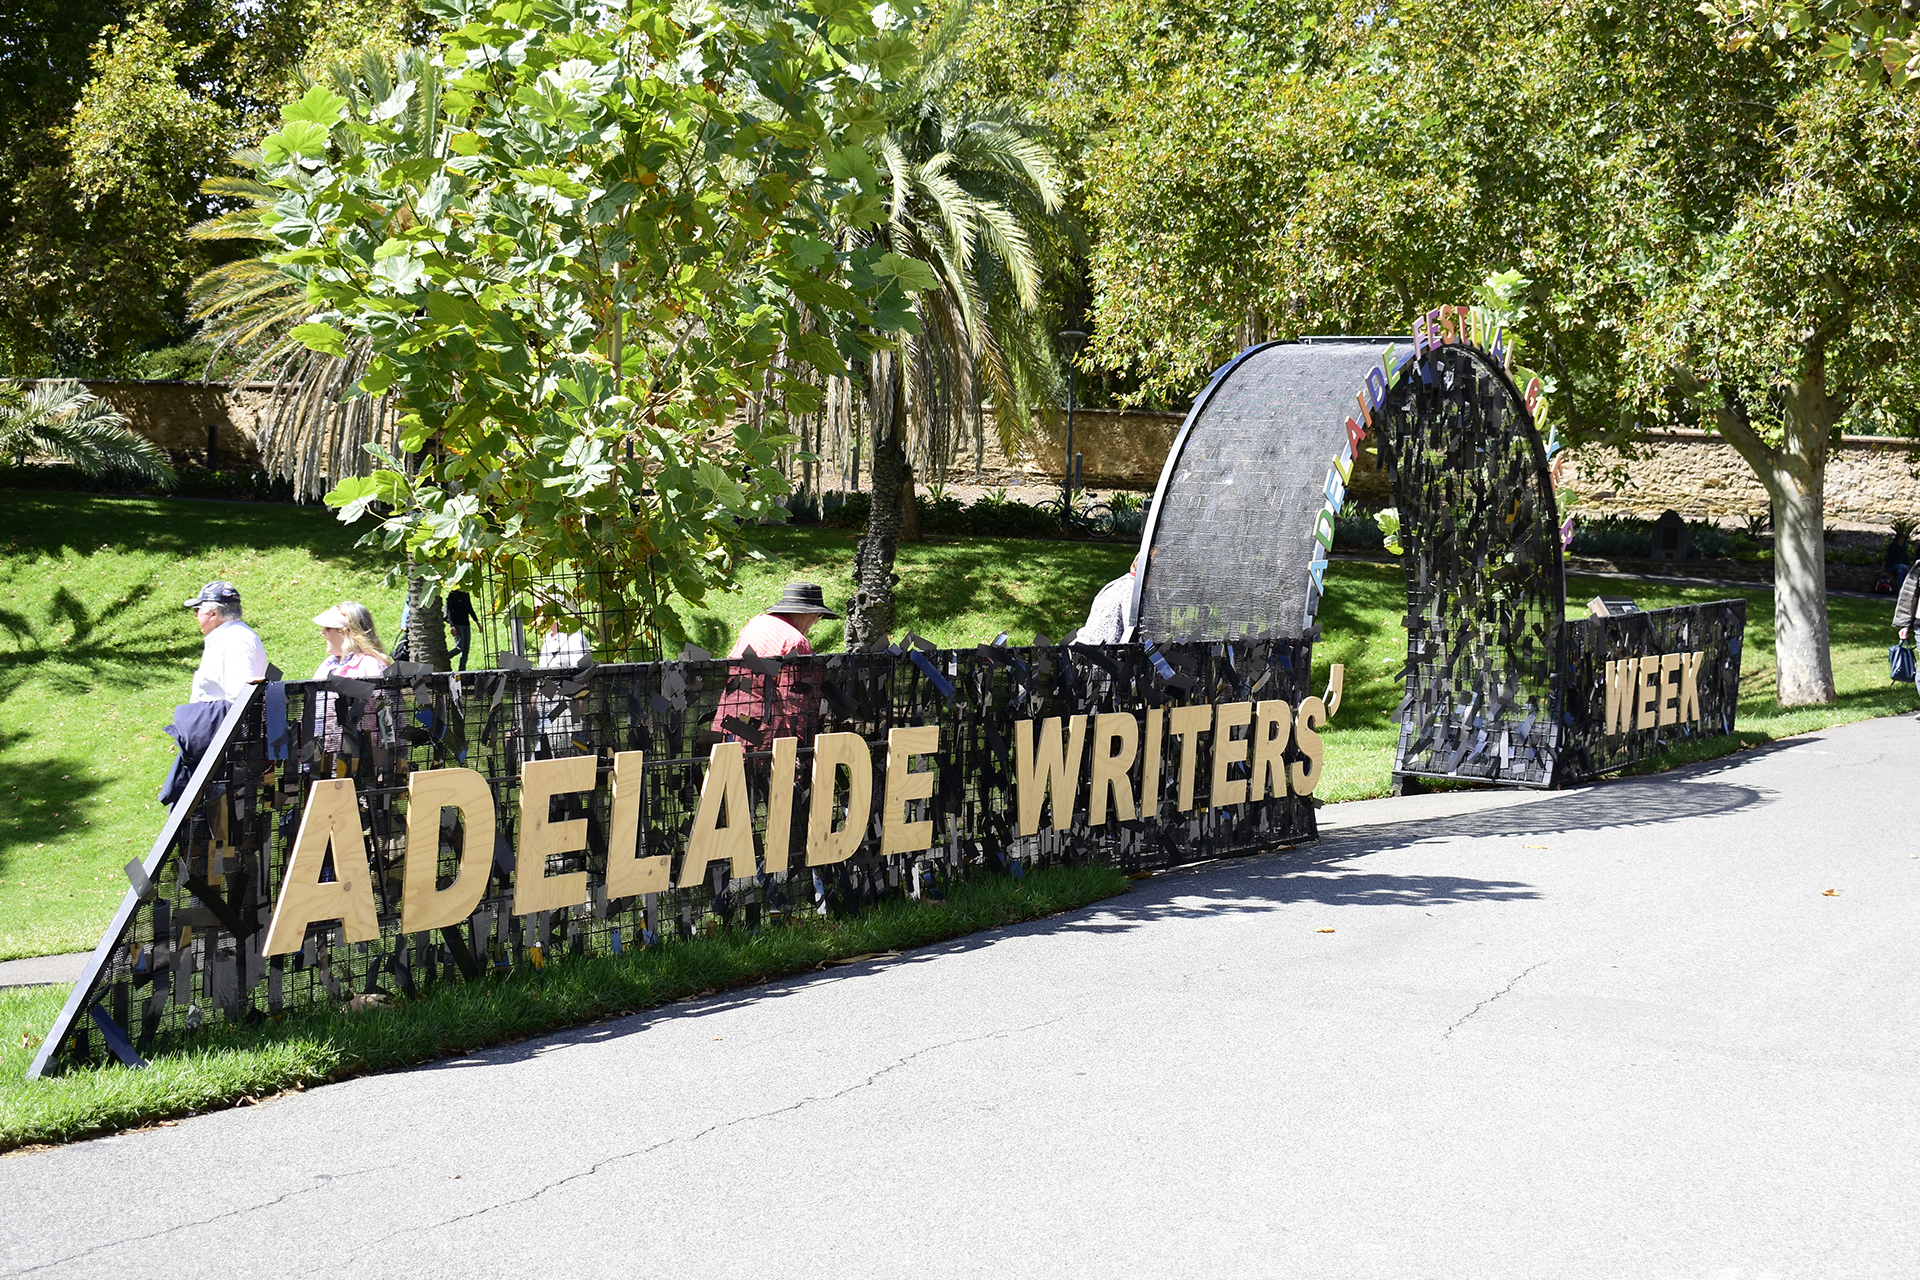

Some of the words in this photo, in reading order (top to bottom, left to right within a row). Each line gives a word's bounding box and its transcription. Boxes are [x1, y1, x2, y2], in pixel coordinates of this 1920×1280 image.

[1307, 341, 1400, 597] ADELAIDE
[1412, 304, 1514, 382] FESTIVAL
[262, 726, 939, 957] ADELAIDE
[1014, 663, 1344, 837] WRITERS'
[1605, 651, 1704, 736] WEEK
